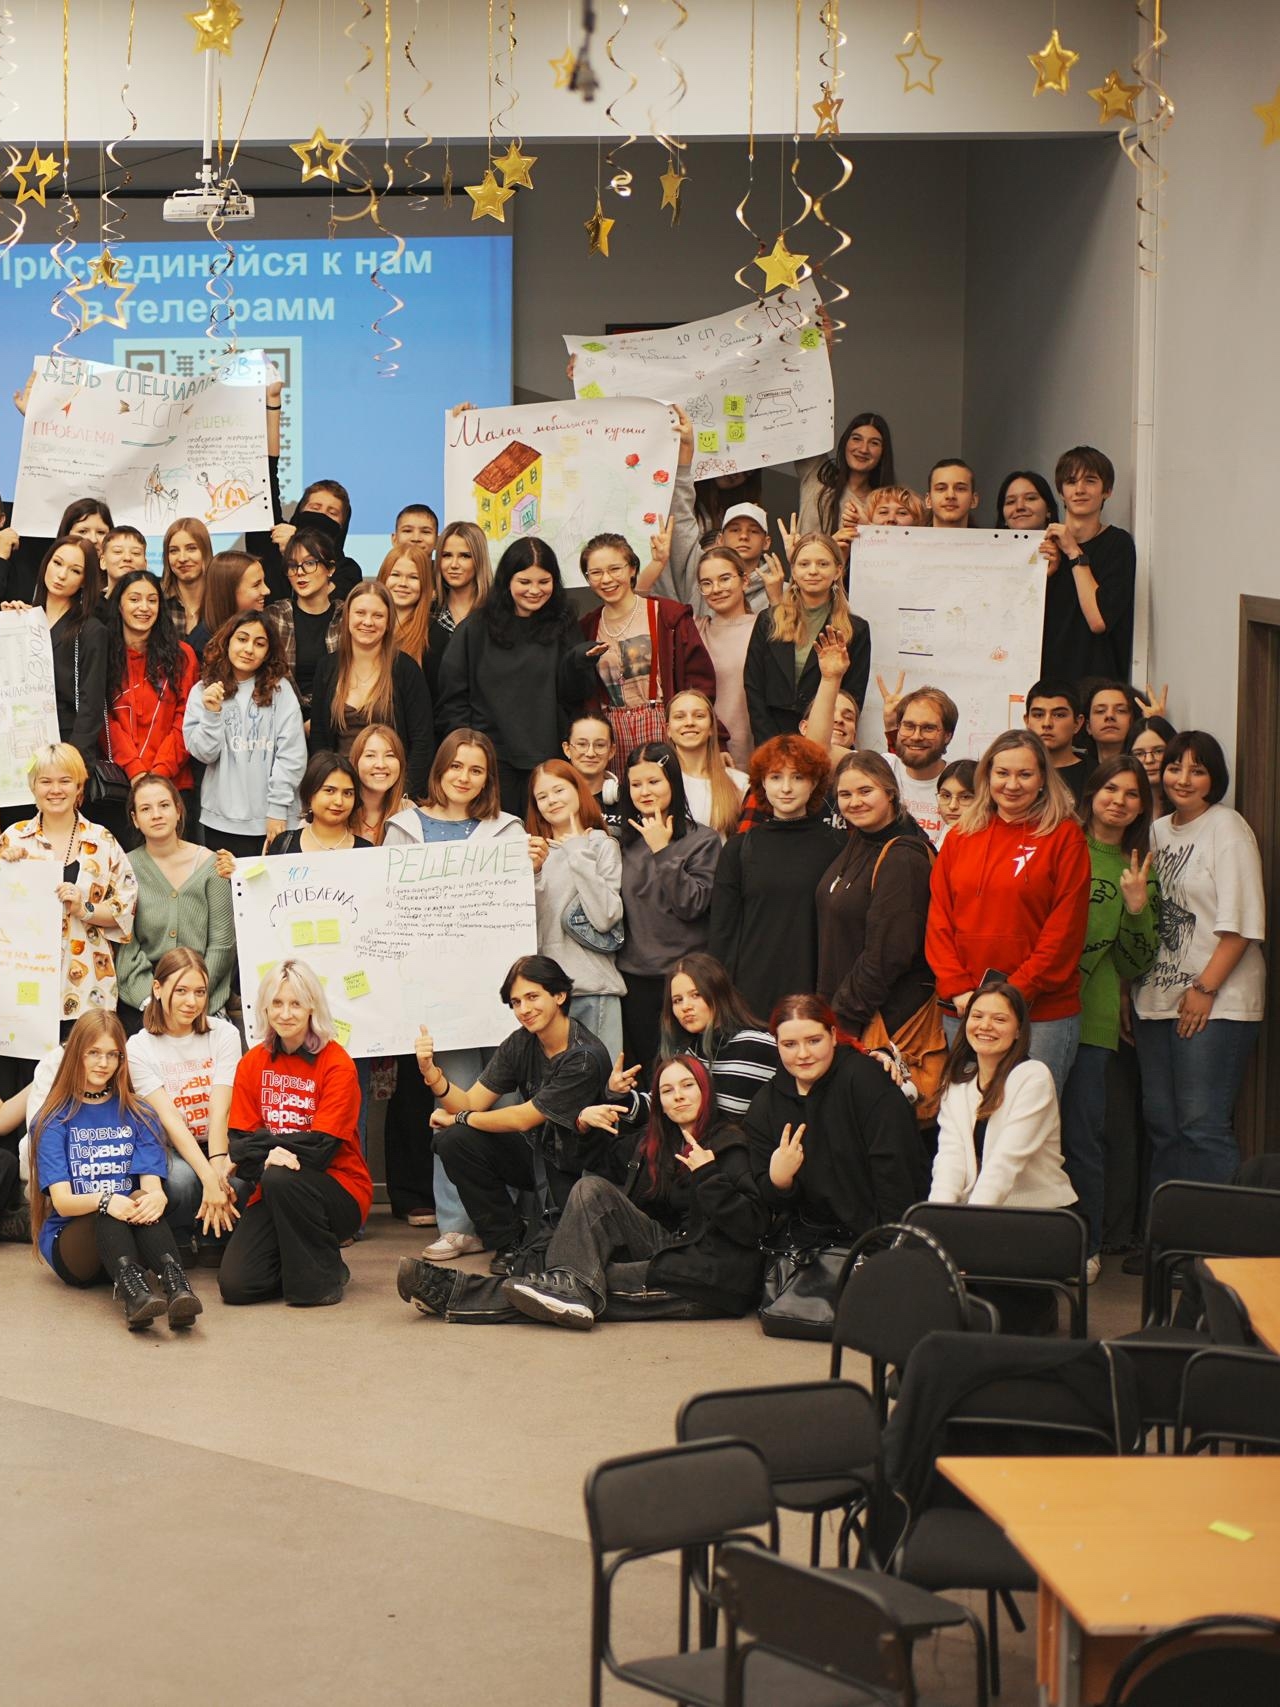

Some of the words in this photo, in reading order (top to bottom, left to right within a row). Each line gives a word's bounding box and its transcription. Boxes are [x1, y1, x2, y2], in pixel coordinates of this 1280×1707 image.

[322, 250, 342, 275] к
[355, 249, 432, 275] нам
[85, 300, 103, 321] в
[677, 333, 690, 346] 10
[698, 327, 715, 342] СП
[450, 415, 522, 447] Малая
[386, 841, 521, 883] РЕШЕНИЕ
[276, 885, 354, 912] ПРОБЛЕМА
[1153, 960, 1181, 975] OPEN
[1154, 972, 1196, 993] INSIDE
[261, 1069, 316, 1092] Первые
[261, 1088, 317, 1111] Первые
[70, 1125, 133, 1145] Первые
[70, 1142, 134, 1163] Первые
[70, 1160, 132, 1180] Первые
